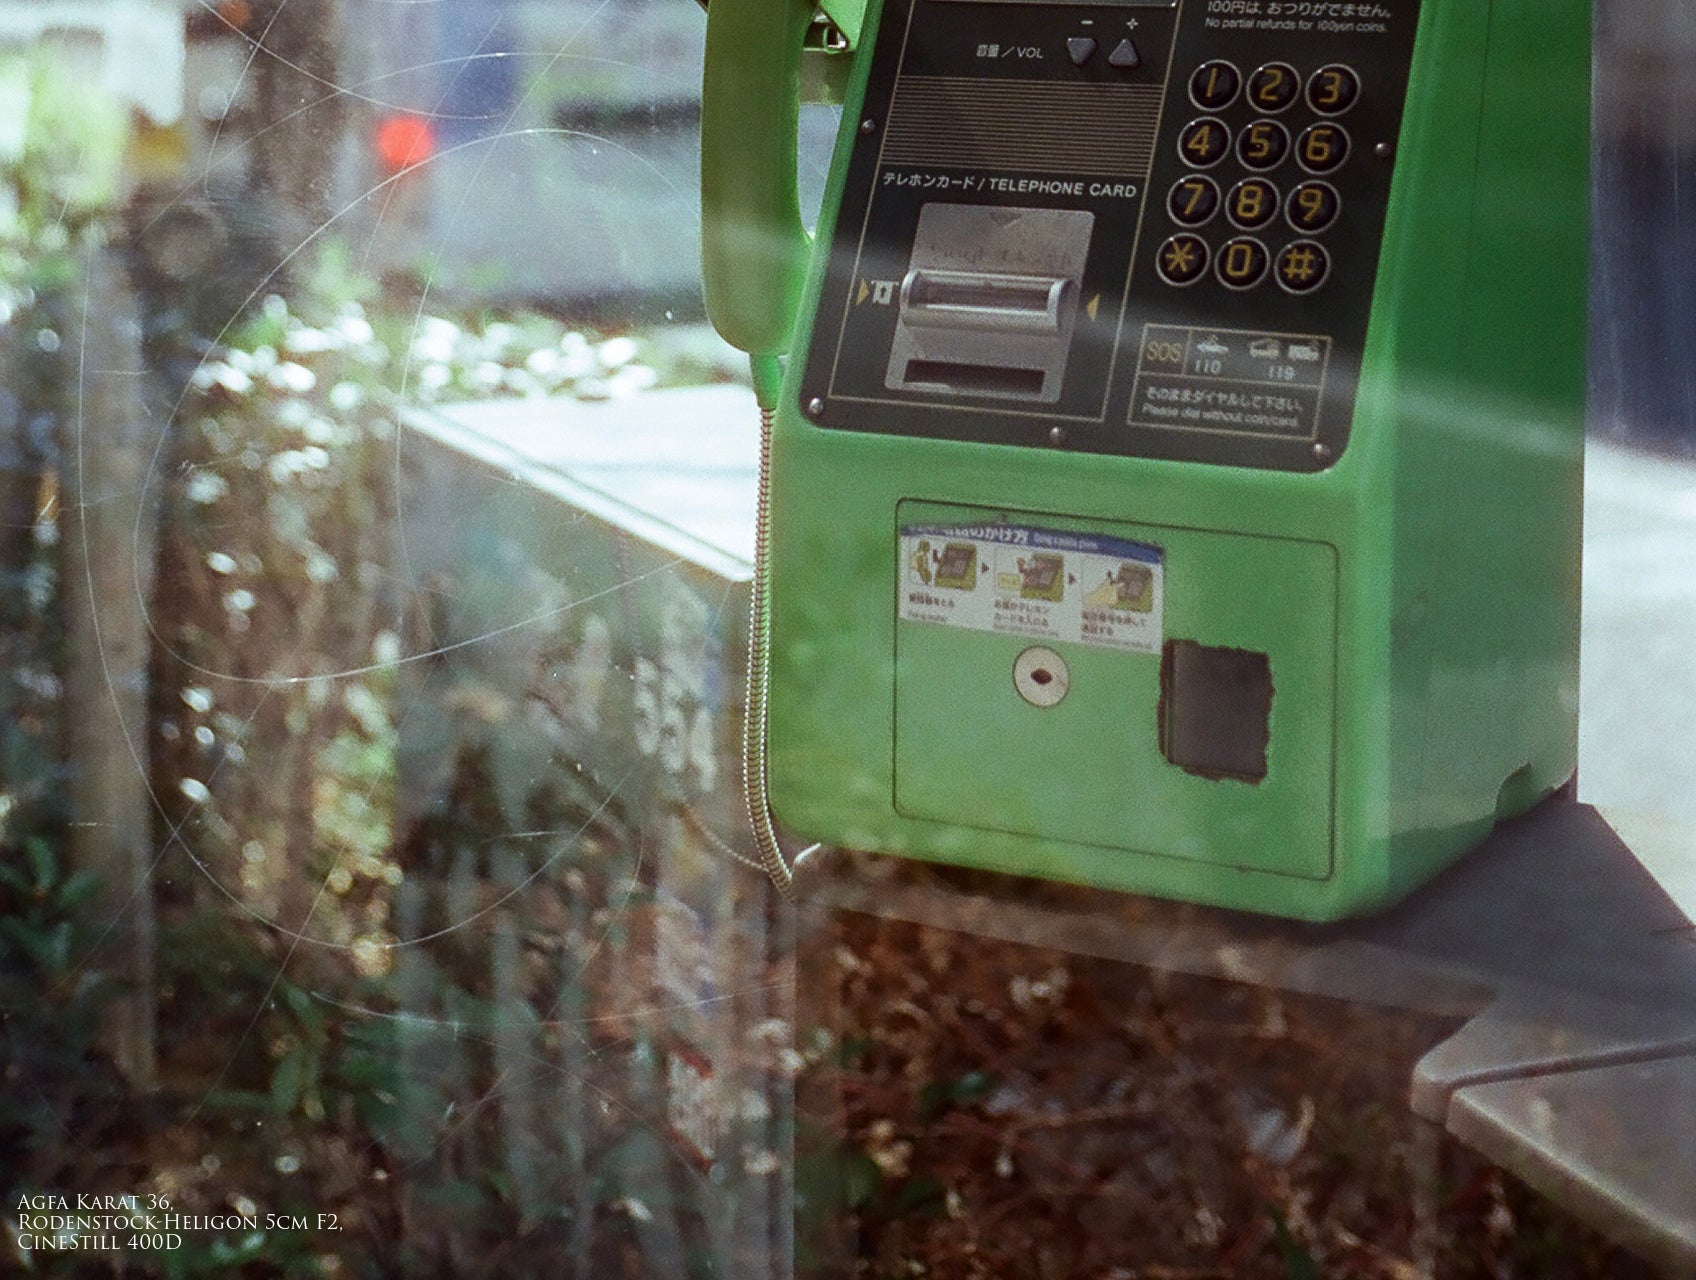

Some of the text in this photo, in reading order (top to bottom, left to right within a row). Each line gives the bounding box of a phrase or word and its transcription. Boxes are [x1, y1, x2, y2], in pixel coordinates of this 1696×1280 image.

[1206, 67, 1342, 104] 1 2 3
[1187, 125, 1332, 161] 4 5 6
[883, 172, 975, 190] テレホンカード
[989, 178, 1083, 195] TELEPHONE
[1089, 183, 1137, 198] CARD
[1184, 183, 1322, 221] 7 8 9
[1225, 243, 1252, 277] 0
[1194, 359, 1222, 375] 110
